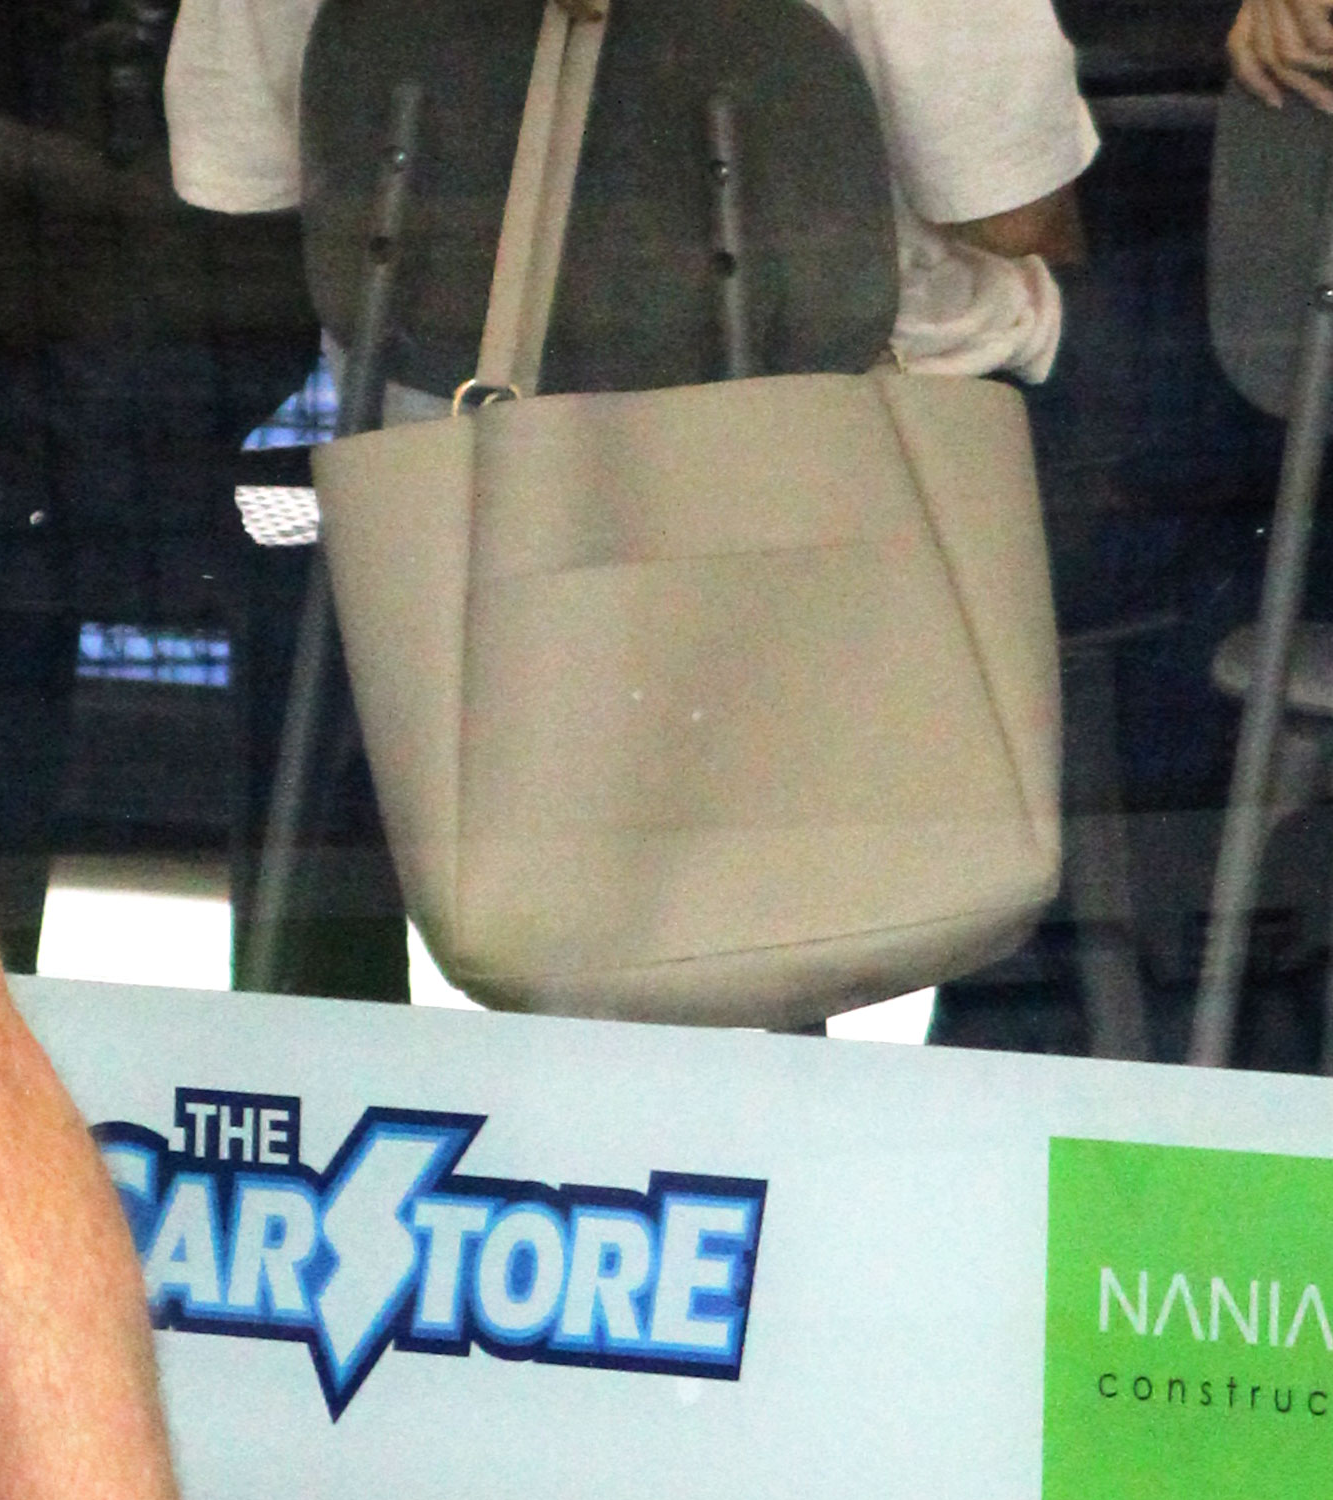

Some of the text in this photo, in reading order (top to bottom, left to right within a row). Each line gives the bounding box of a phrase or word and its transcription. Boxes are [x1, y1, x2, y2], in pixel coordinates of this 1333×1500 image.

[184, 1101, 290, 1165] THE
[1098, 1266, 1333, 1351] NANIA
[1097, 1372, 1328, 1416] construc
